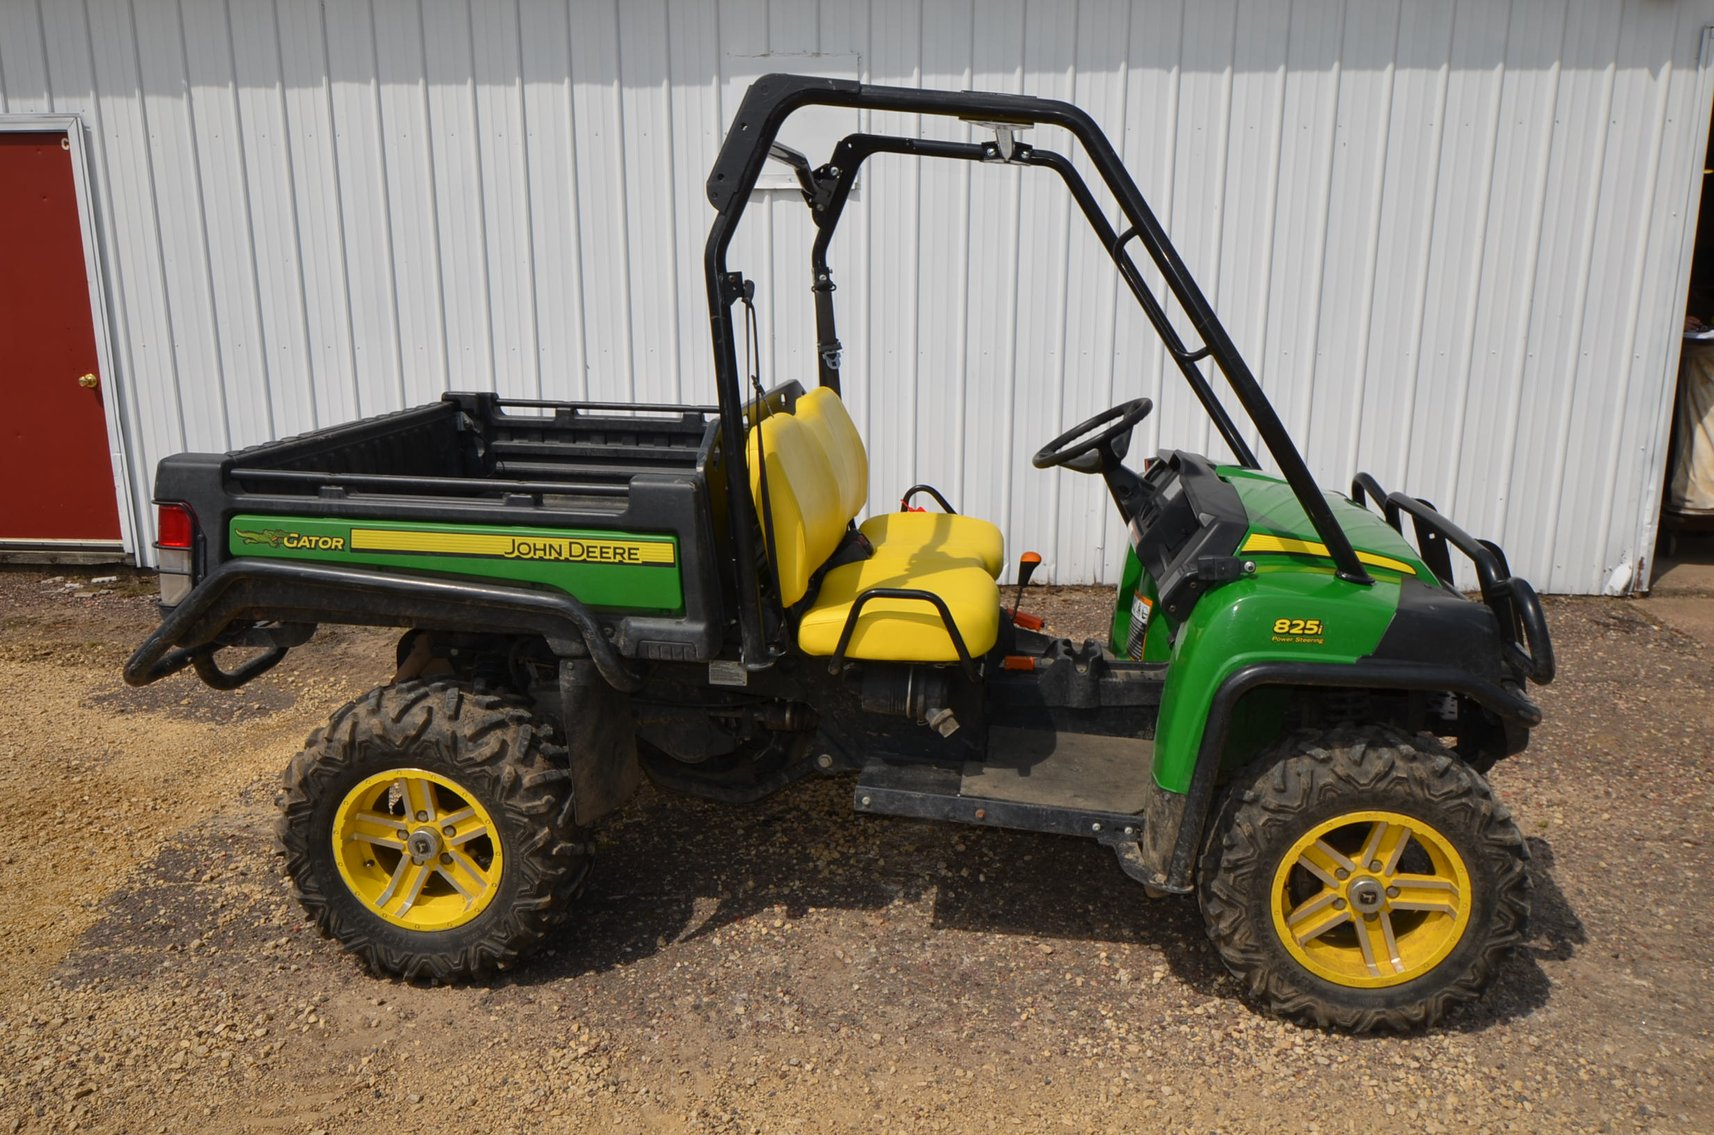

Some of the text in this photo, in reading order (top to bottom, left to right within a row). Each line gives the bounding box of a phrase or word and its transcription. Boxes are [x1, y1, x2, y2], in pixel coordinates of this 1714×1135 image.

[283, 533, 344, 549] GATOR
[504, 538, 640, 561] JOHN DEERE
[1273, 619, 1323, 635] 825i
